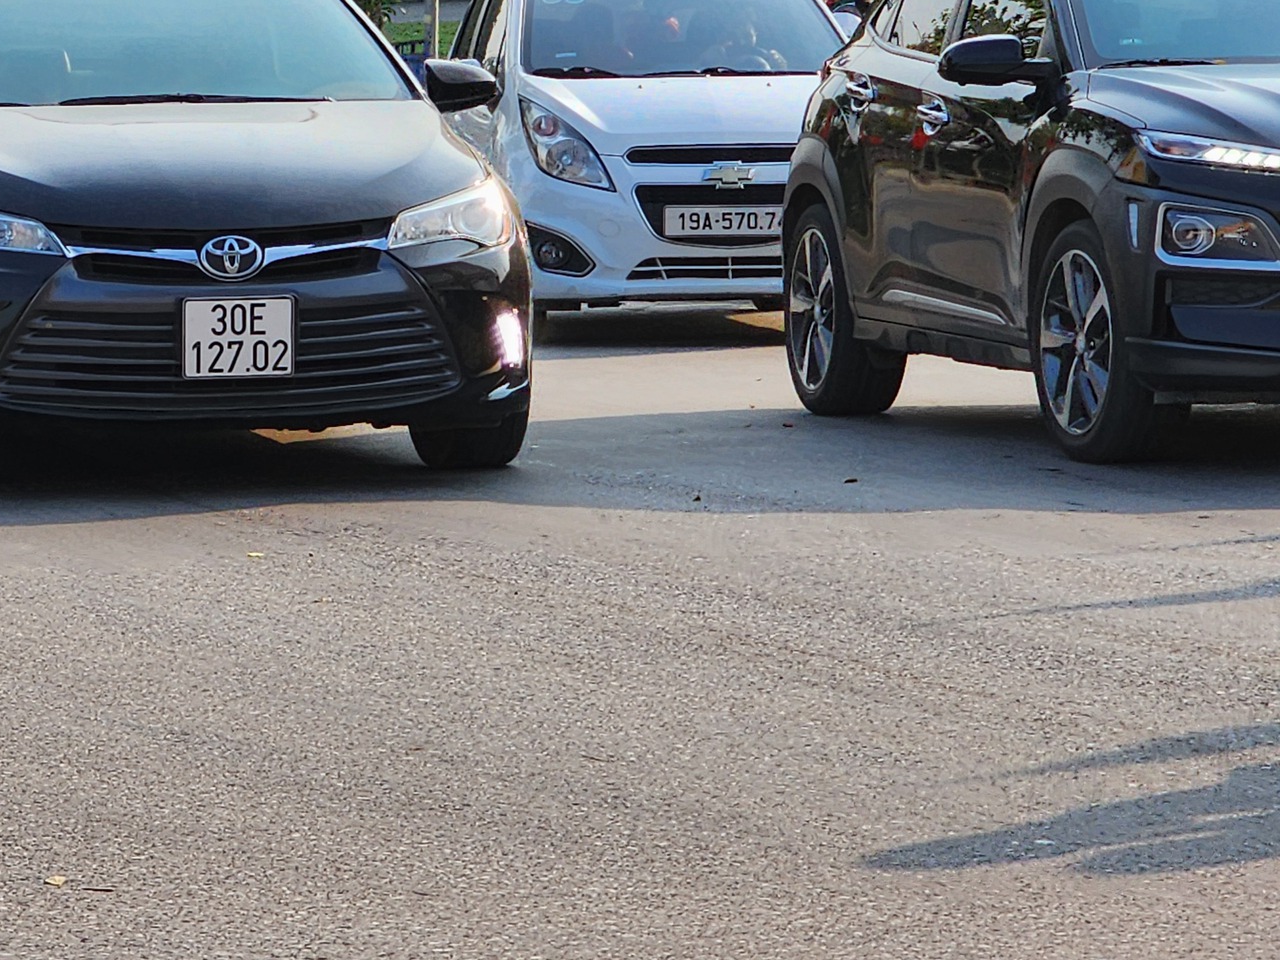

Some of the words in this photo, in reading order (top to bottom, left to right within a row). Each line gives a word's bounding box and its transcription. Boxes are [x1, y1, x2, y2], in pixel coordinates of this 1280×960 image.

[678, 212, 783, 230] 19A-570.7
[211, 303, 266, 336] 30E
[192, 340, 288, 374] 127.02
